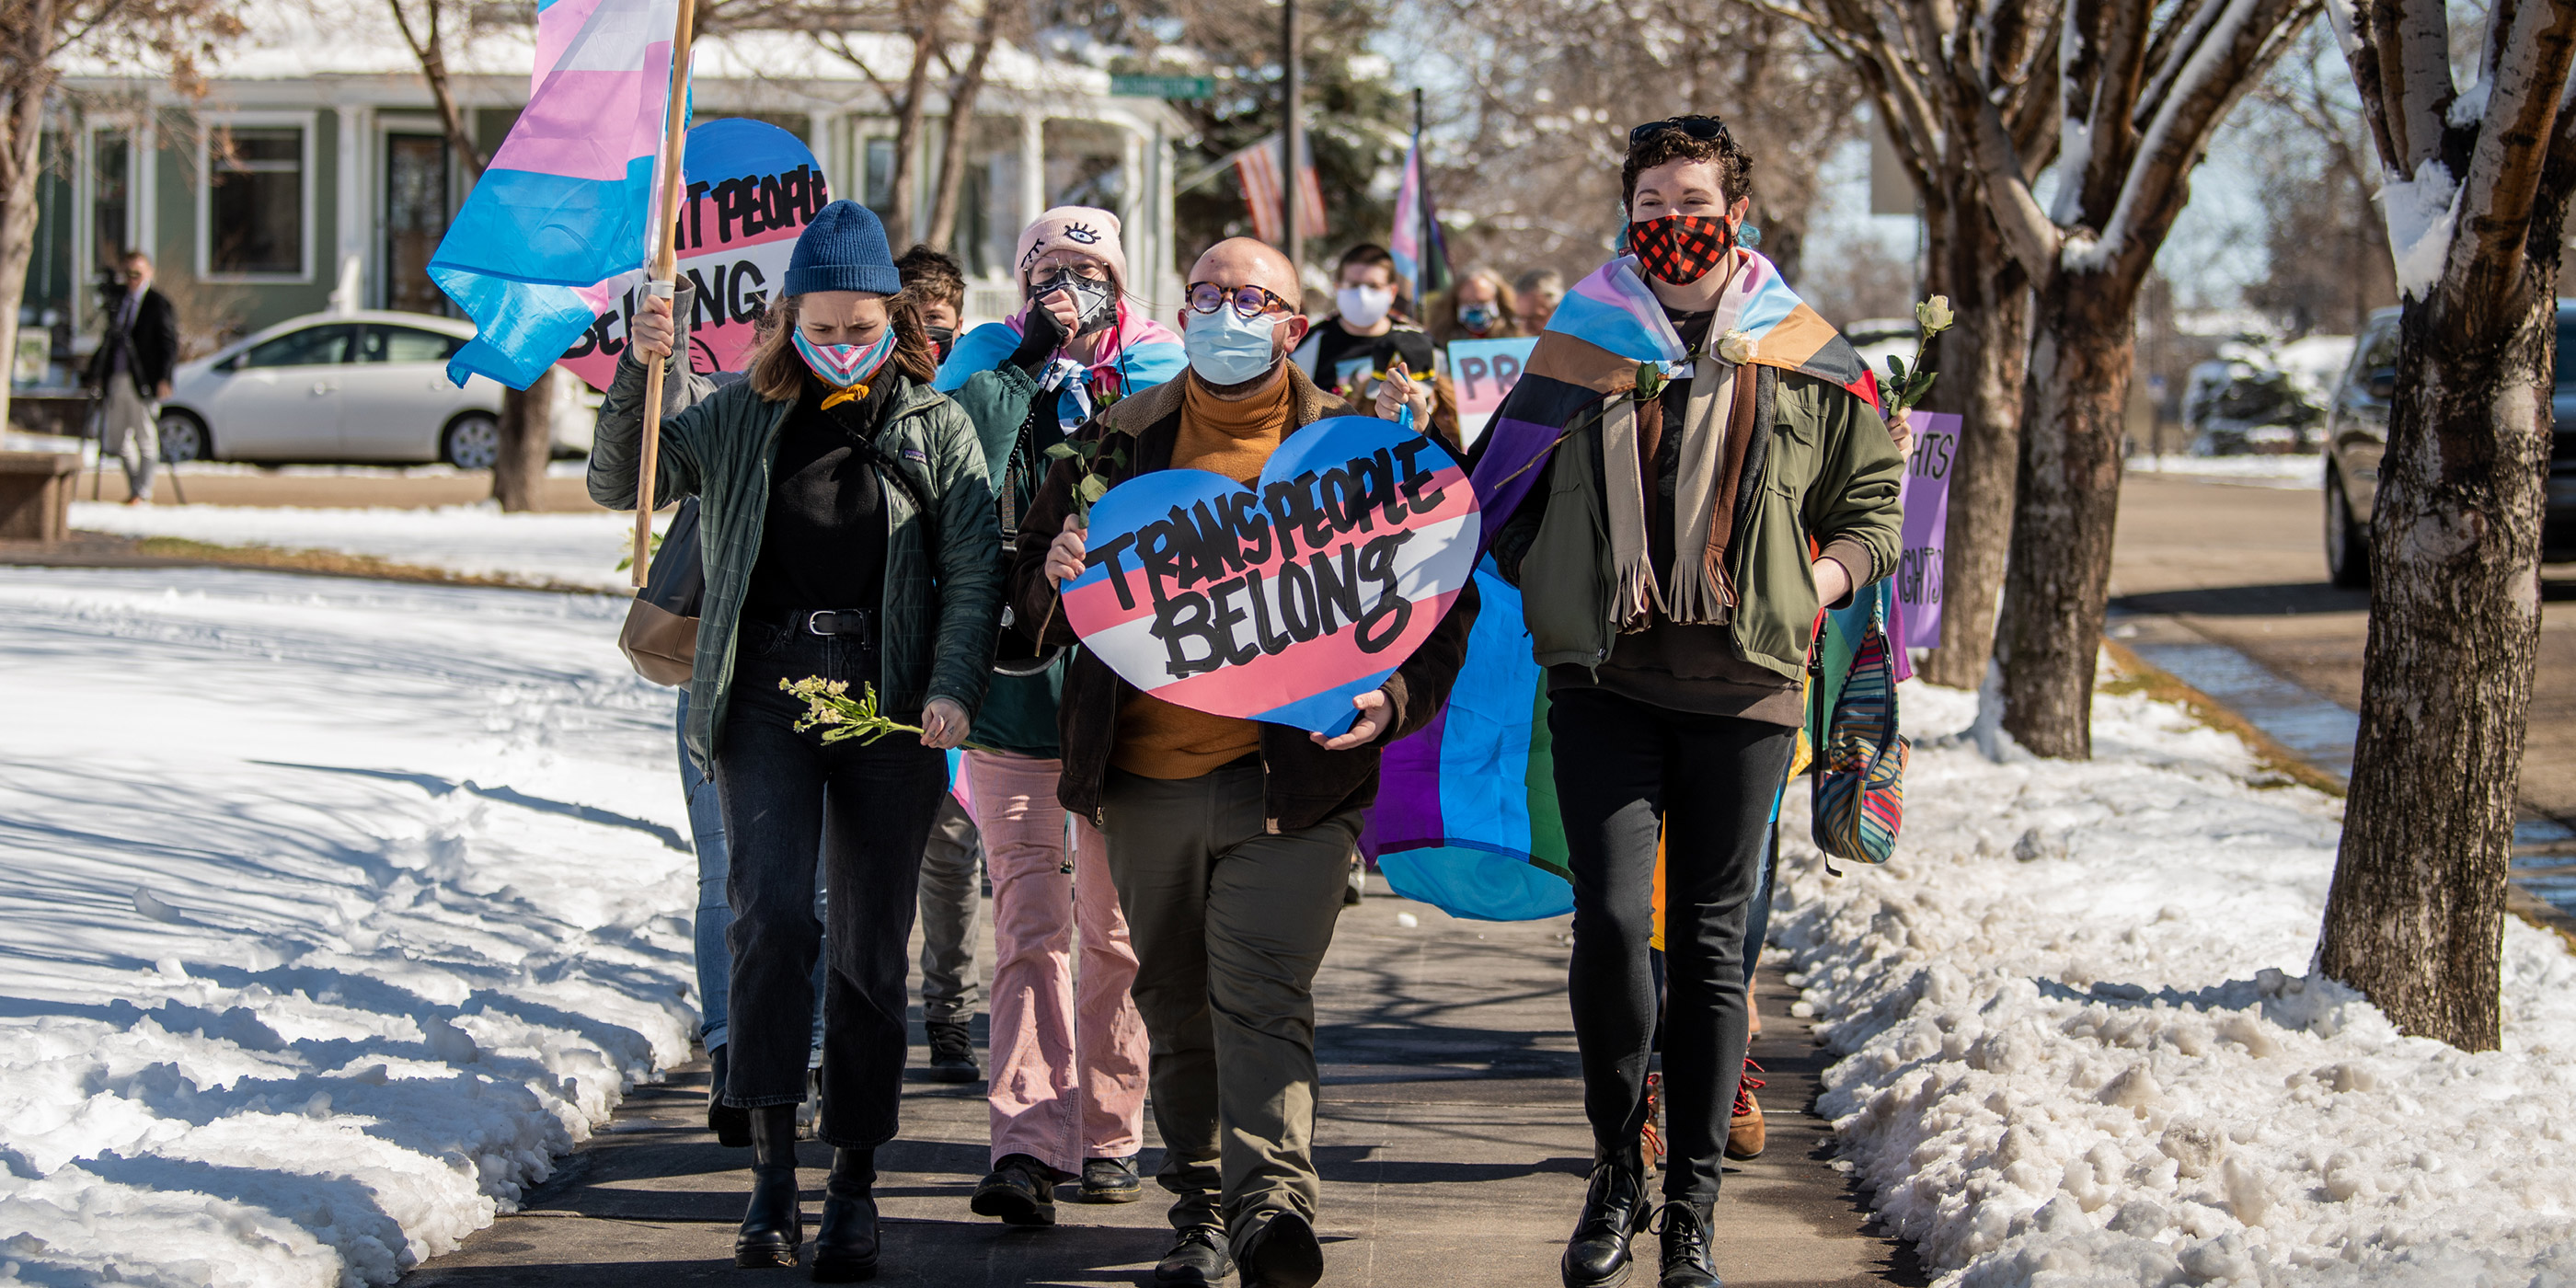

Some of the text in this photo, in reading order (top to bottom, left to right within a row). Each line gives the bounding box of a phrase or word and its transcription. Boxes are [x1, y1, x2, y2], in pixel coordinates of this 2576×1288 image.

[710, 164, 828, 244] PEOPLE
[1086, 435, 1446, 611] TRANS PEOPLE
